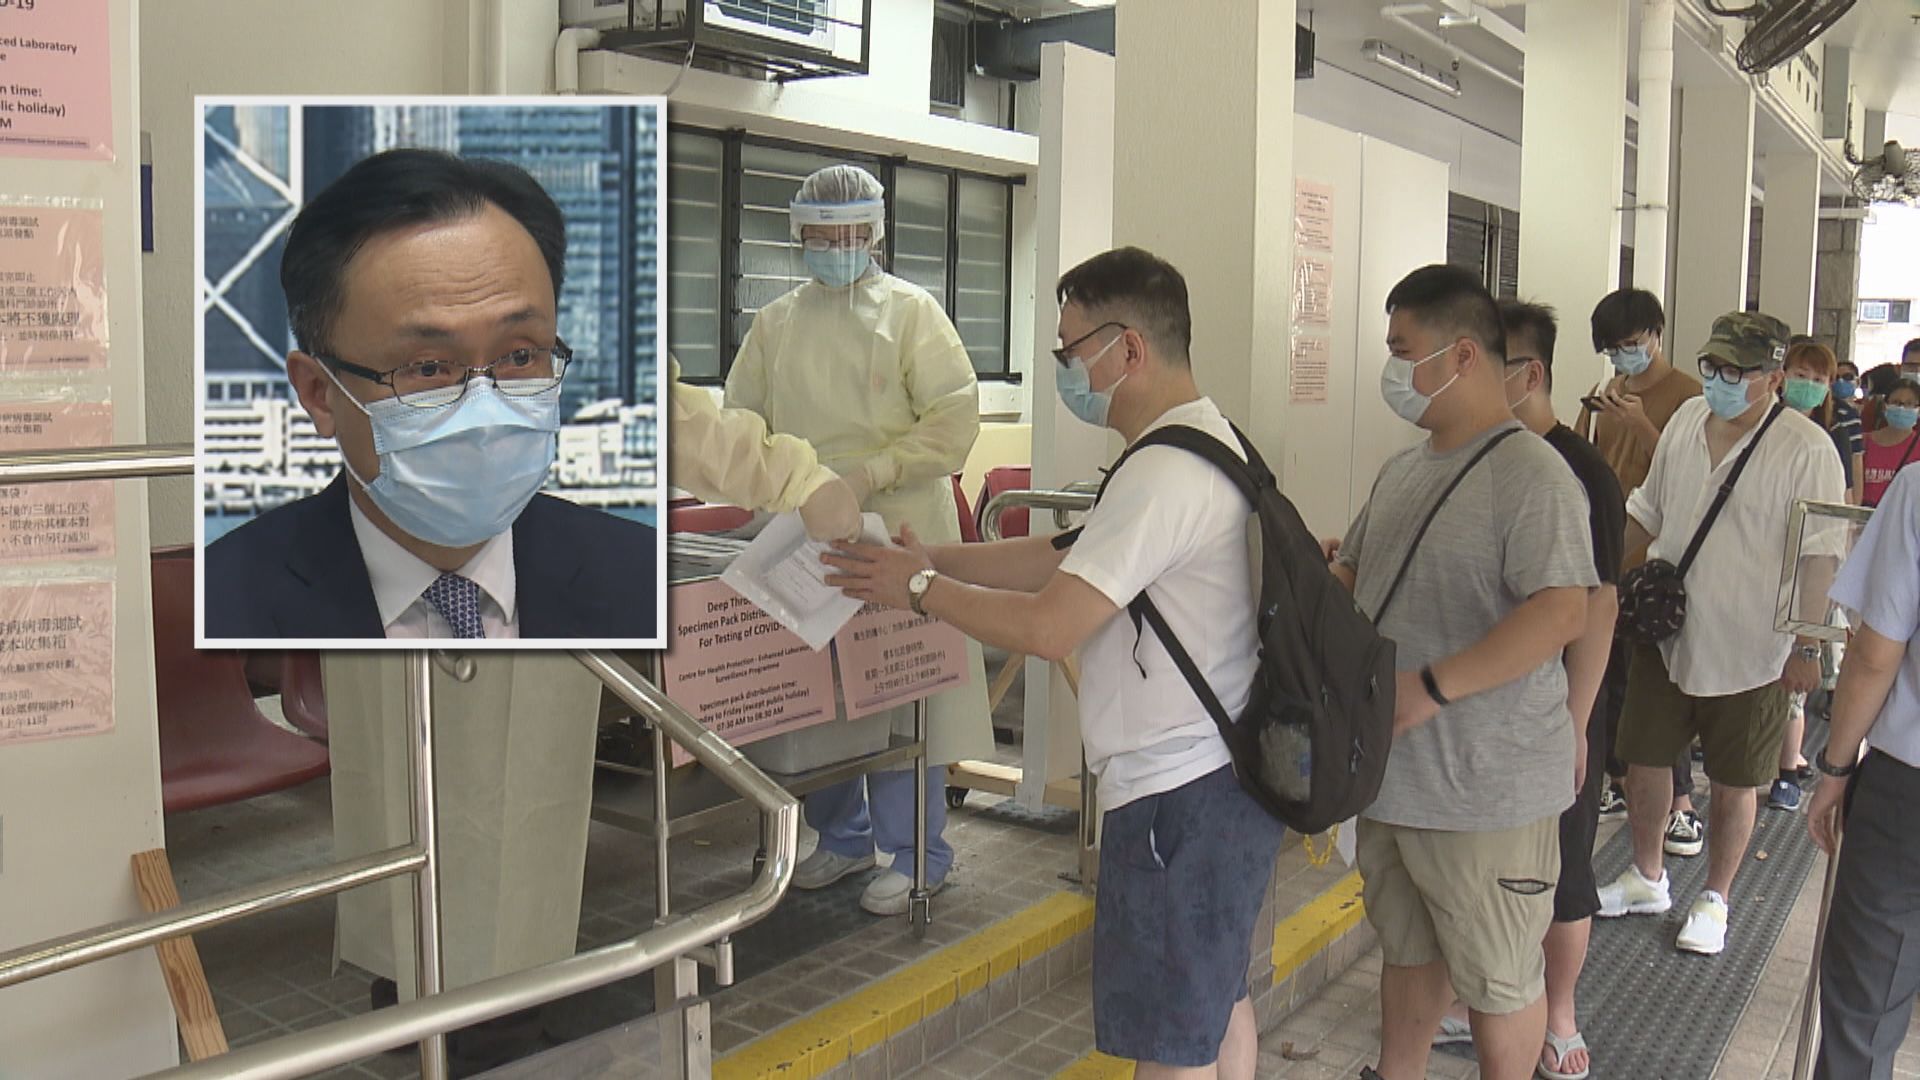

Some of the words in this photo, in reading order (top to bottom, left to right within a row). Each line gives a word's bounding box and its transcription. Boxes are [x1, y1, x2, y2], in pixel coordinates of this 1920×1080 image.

[20, 38, 77, 55] Laboratory
[11, 84, 42, 97] time:
[18, 101, 66, 117] holiday)
[0, 118, 12, 129] M
[707, 600, 728, 614] Deep
[678, 619, 719, 637] Specimen
[720, 614, 739, 627] Pack
[699, 635, 713, 649] For
[714, 629, 743, 644] Testing
[744, 628, 753, 637] of
[678, 671, 697, 682] Centre
[698, 668, 706, 677] for
[707, 663, 725, 675] Health
[726, 656, 754, 671] Protection
[758, 649, 784, 662] Enhanced
[715, 671, 748, 684] Surveillance
[699, 698, 729, 712] Specimen
[730, 692, 744, 704] pack
[745, 683, 781, 700] distribution
[782, 680, 798, 690] time:
[715, 711, 722, 721] to
[723, 705, 742, 719] Friday
[743, 700, 765, 714] (except
[766, 695, 784, 709] public
[785, 687, 810, 701] holiday)
[735, 716, 746, 727] AM
[747, 713, 754, 723] to
[773, 705, 785, 717] AM
